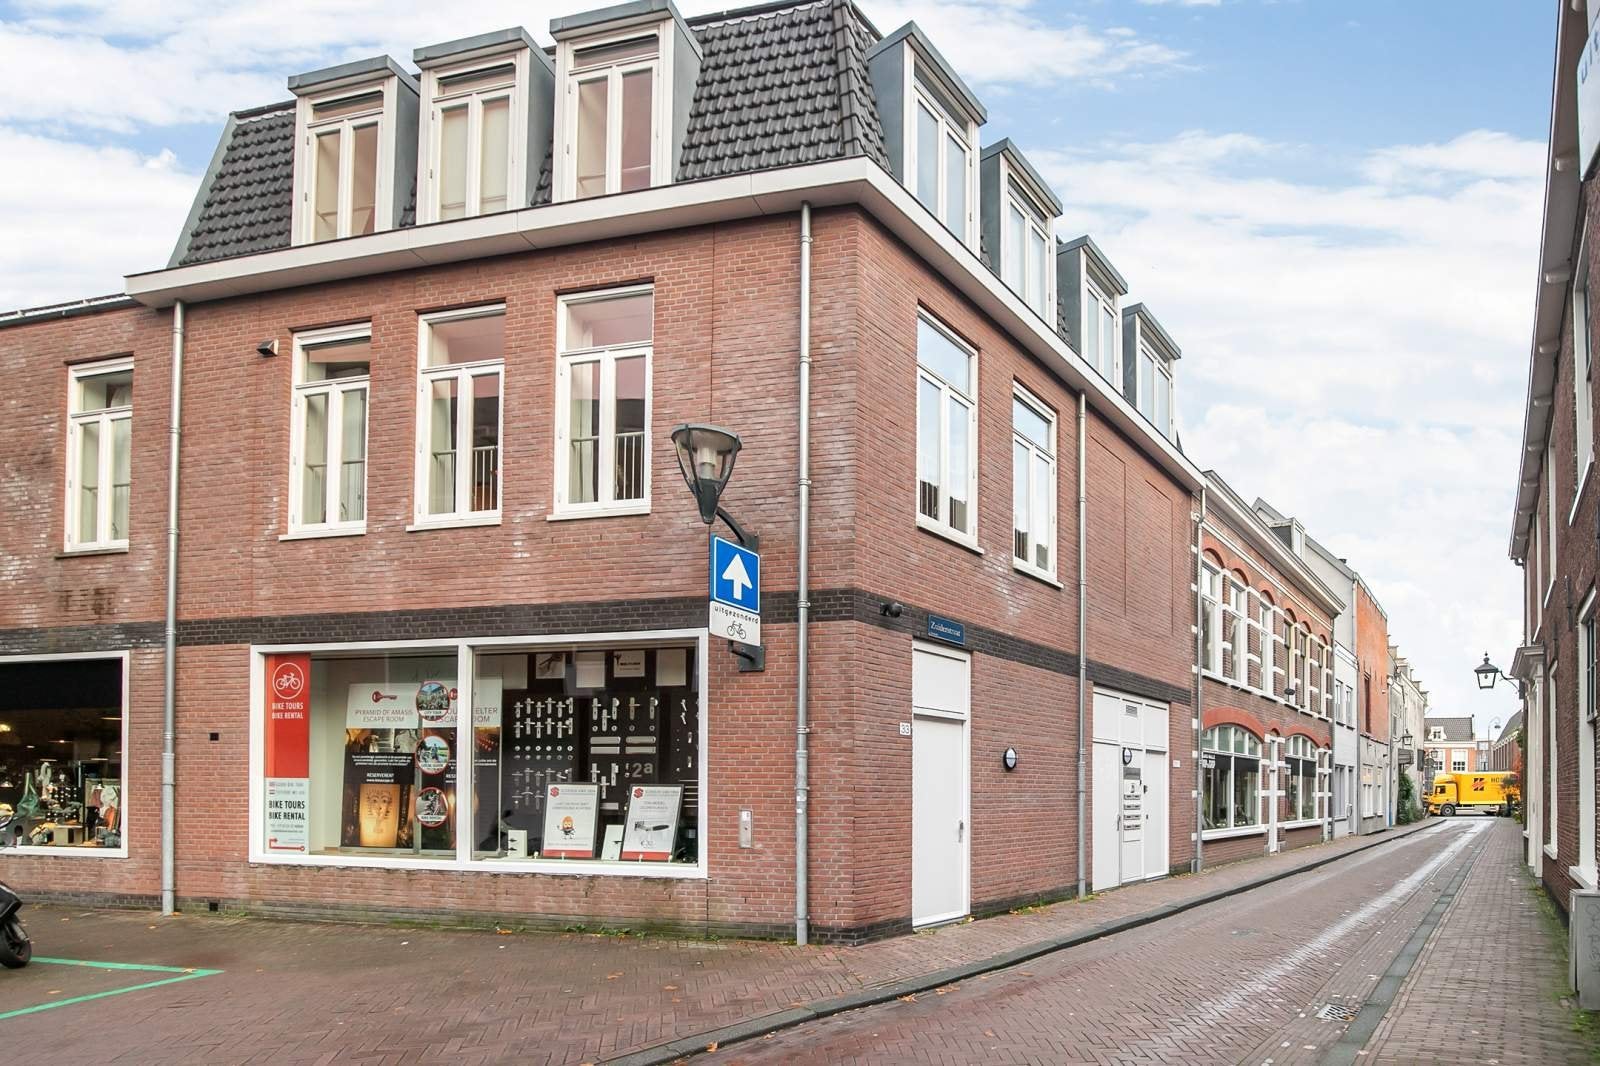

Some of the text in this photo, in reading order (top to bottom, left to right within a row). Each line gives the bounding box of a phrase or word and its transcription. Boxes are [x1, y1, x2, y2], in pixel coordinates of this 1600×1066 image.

[714, 605, 759, 624] uitgezonderd
[271, 702, 304, 710] BIKE TOURS
[271, 711, 304, 720] BIKE RENTAL
[354, 709, 381, 717] PYRAMID
[362, 715, 385, 723] ESCAPE
[900, 723, 910, 734] 33
[632, 762, 653, 777] 2a
[269, 800, 306, 809] BIKE TOURS
[269, 811, 306, 821] BIKE RENTAL
